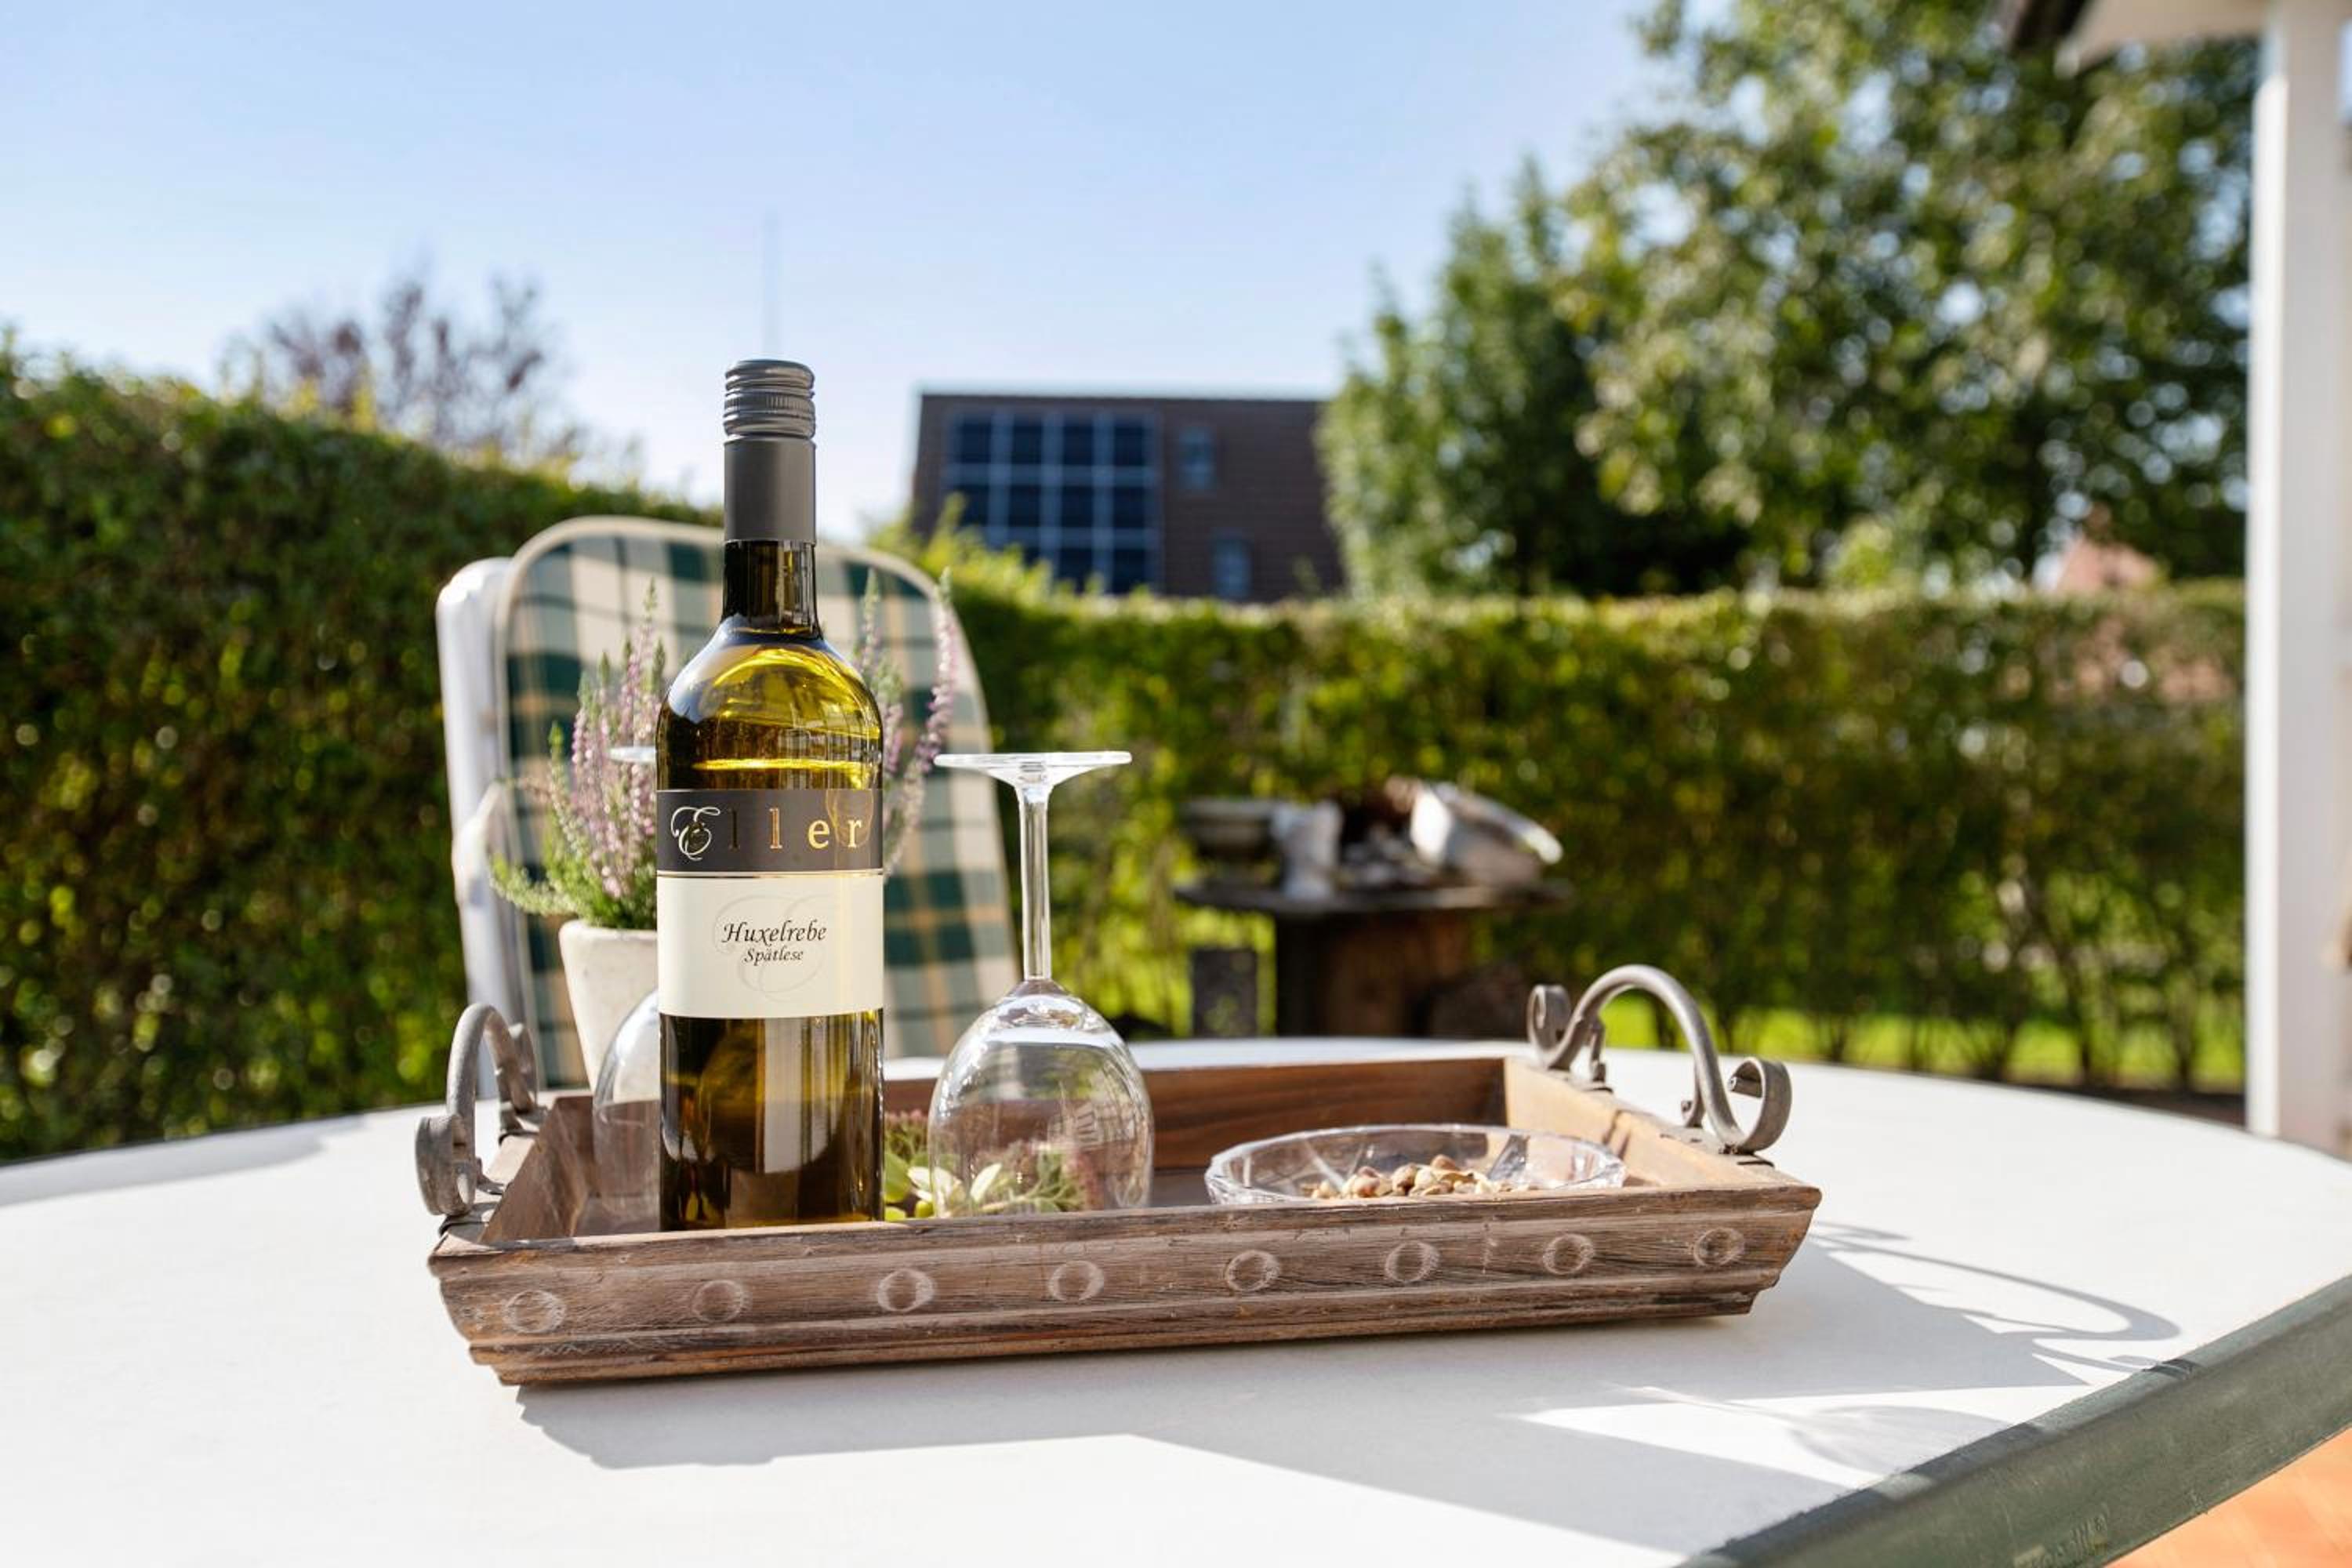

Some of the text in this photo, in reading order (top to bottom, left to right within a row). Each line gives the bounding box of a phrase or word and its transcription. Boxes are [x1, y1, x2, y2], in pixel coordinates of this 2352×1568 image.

[670, 806, 862, 861] Eller
[721, 919, 827, 946] Huxelrebe
[743, 946, 804, 966] Spätlese
